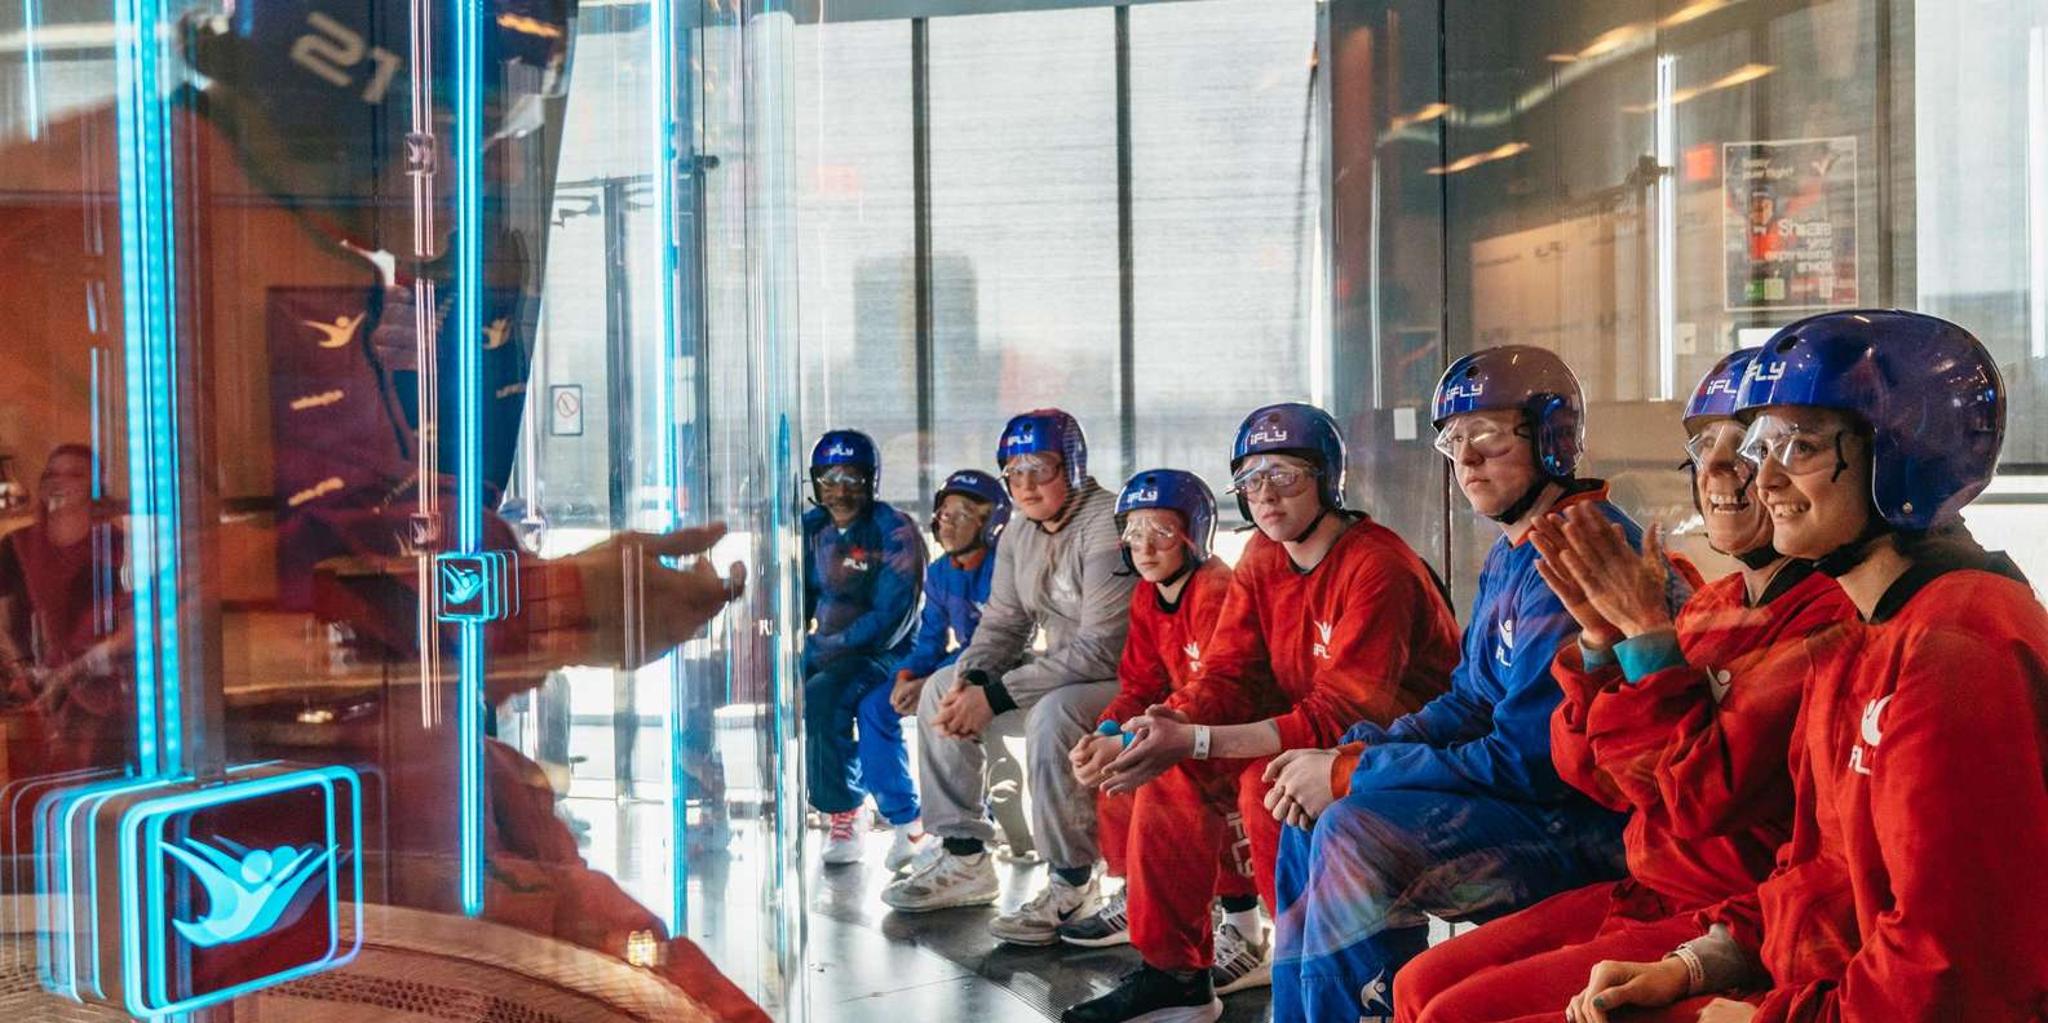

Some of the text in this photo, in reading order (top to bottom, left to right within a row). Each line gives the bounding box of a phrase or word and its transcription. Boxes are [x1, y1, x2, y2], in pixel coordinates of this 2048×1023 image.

[1706, 379, 1737, 395] iFL
[1250, 430, 1288, 445] iFLY
[1313, 642, 1331, 660] iFL
